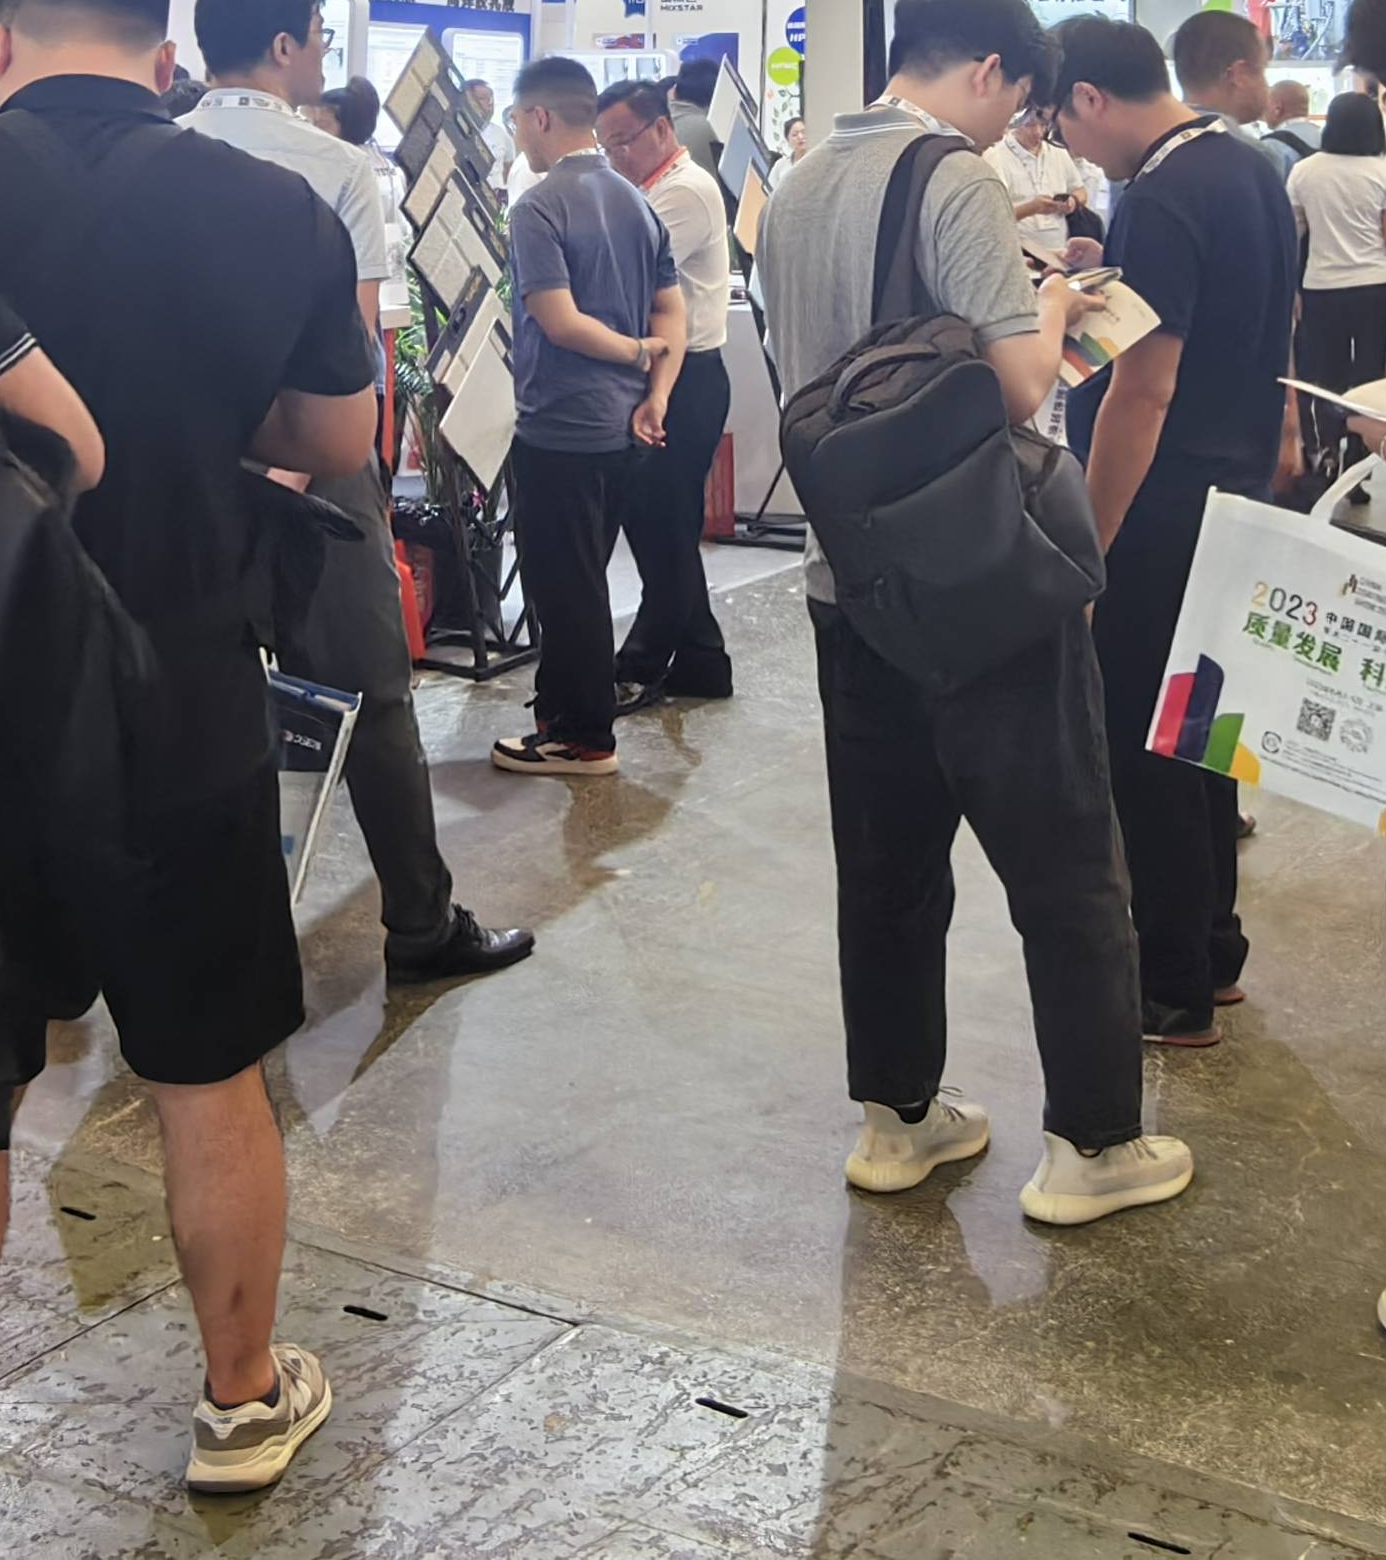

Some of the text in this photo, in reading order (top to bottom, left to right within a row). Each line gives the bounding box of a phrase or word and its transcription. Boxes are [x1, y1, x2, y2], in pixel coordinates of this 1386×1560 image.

[1250, 581, 1318, 627] 2023
[1242, 610, 1344, 673] 质量发展
